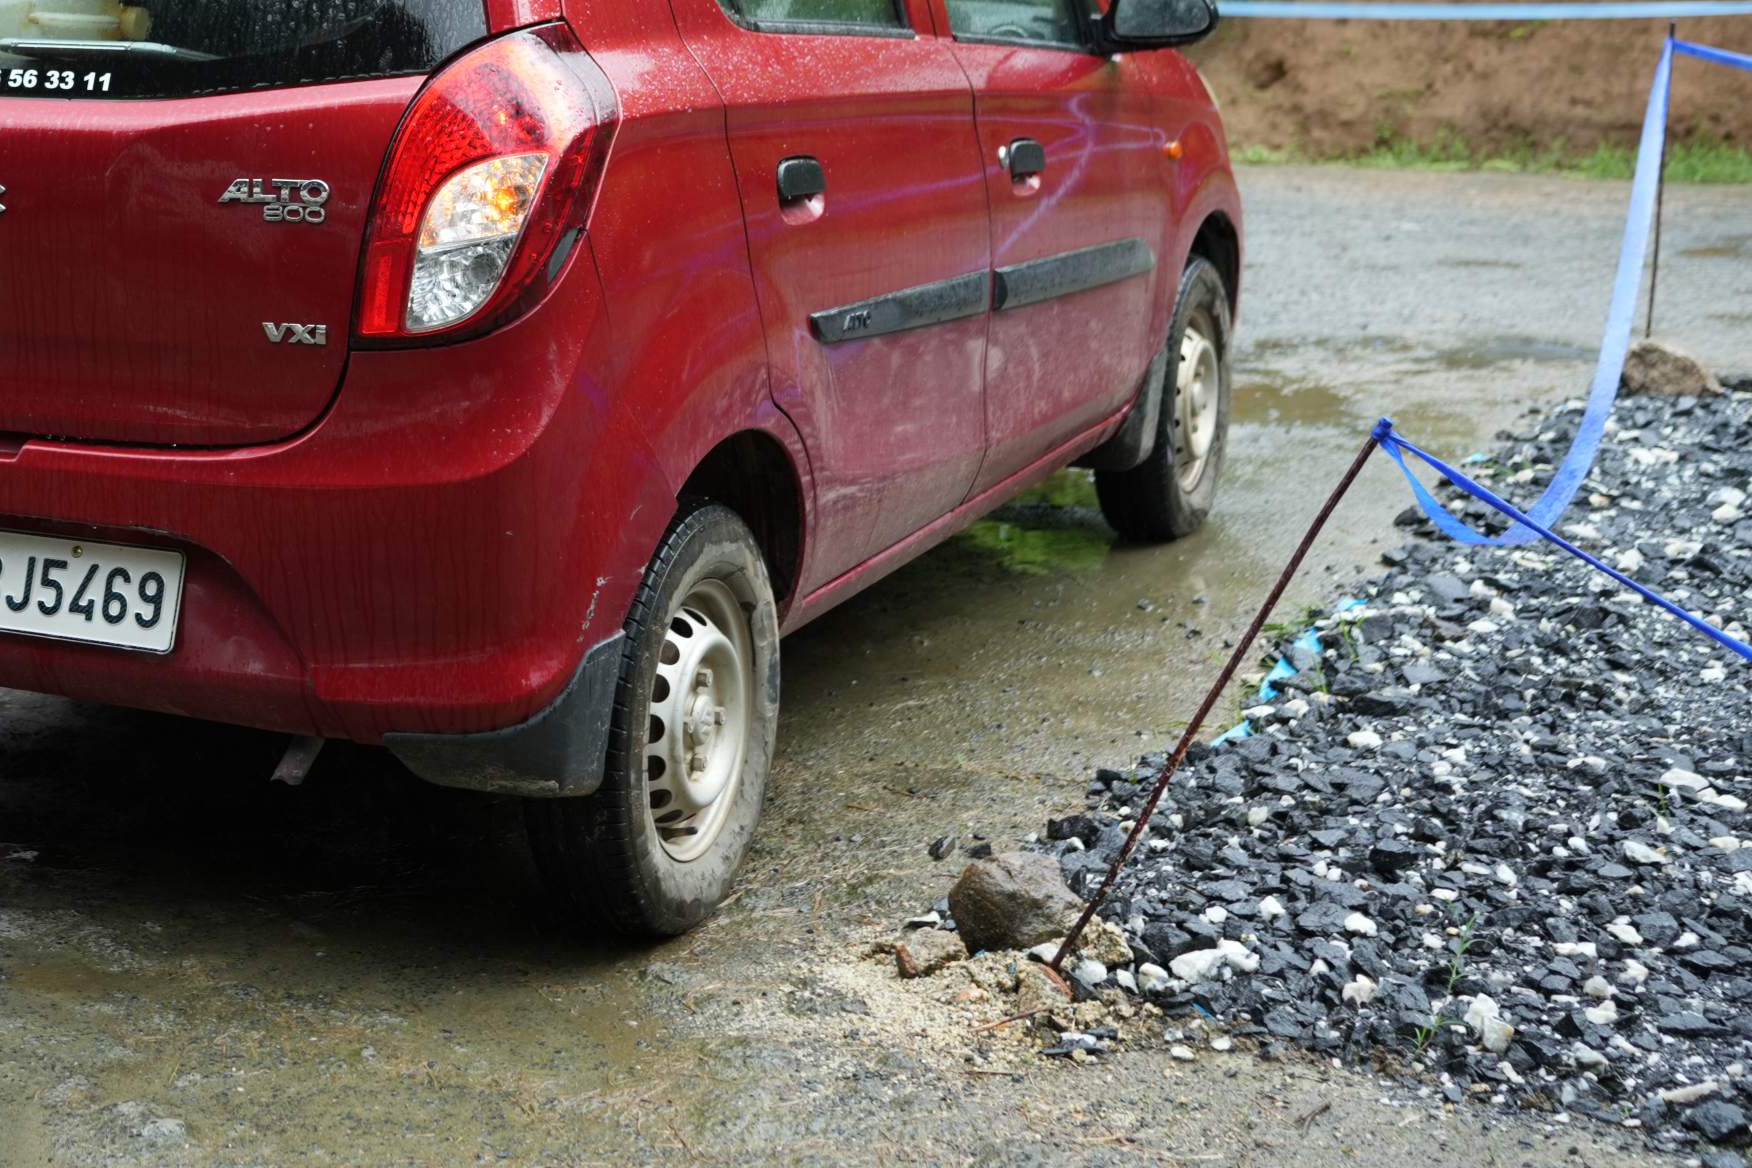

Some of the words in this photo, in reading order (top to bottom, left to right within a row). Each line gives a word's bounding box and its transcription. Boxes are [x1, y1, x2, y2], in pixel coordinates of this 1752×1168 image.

[8, 68, 38, 88] 56
[44, 70, 75, 90] 33
[83, 72, 112, 91] 11
[217, 178, 330, 206] ALTO
[263, 203, 326, 224] 800
